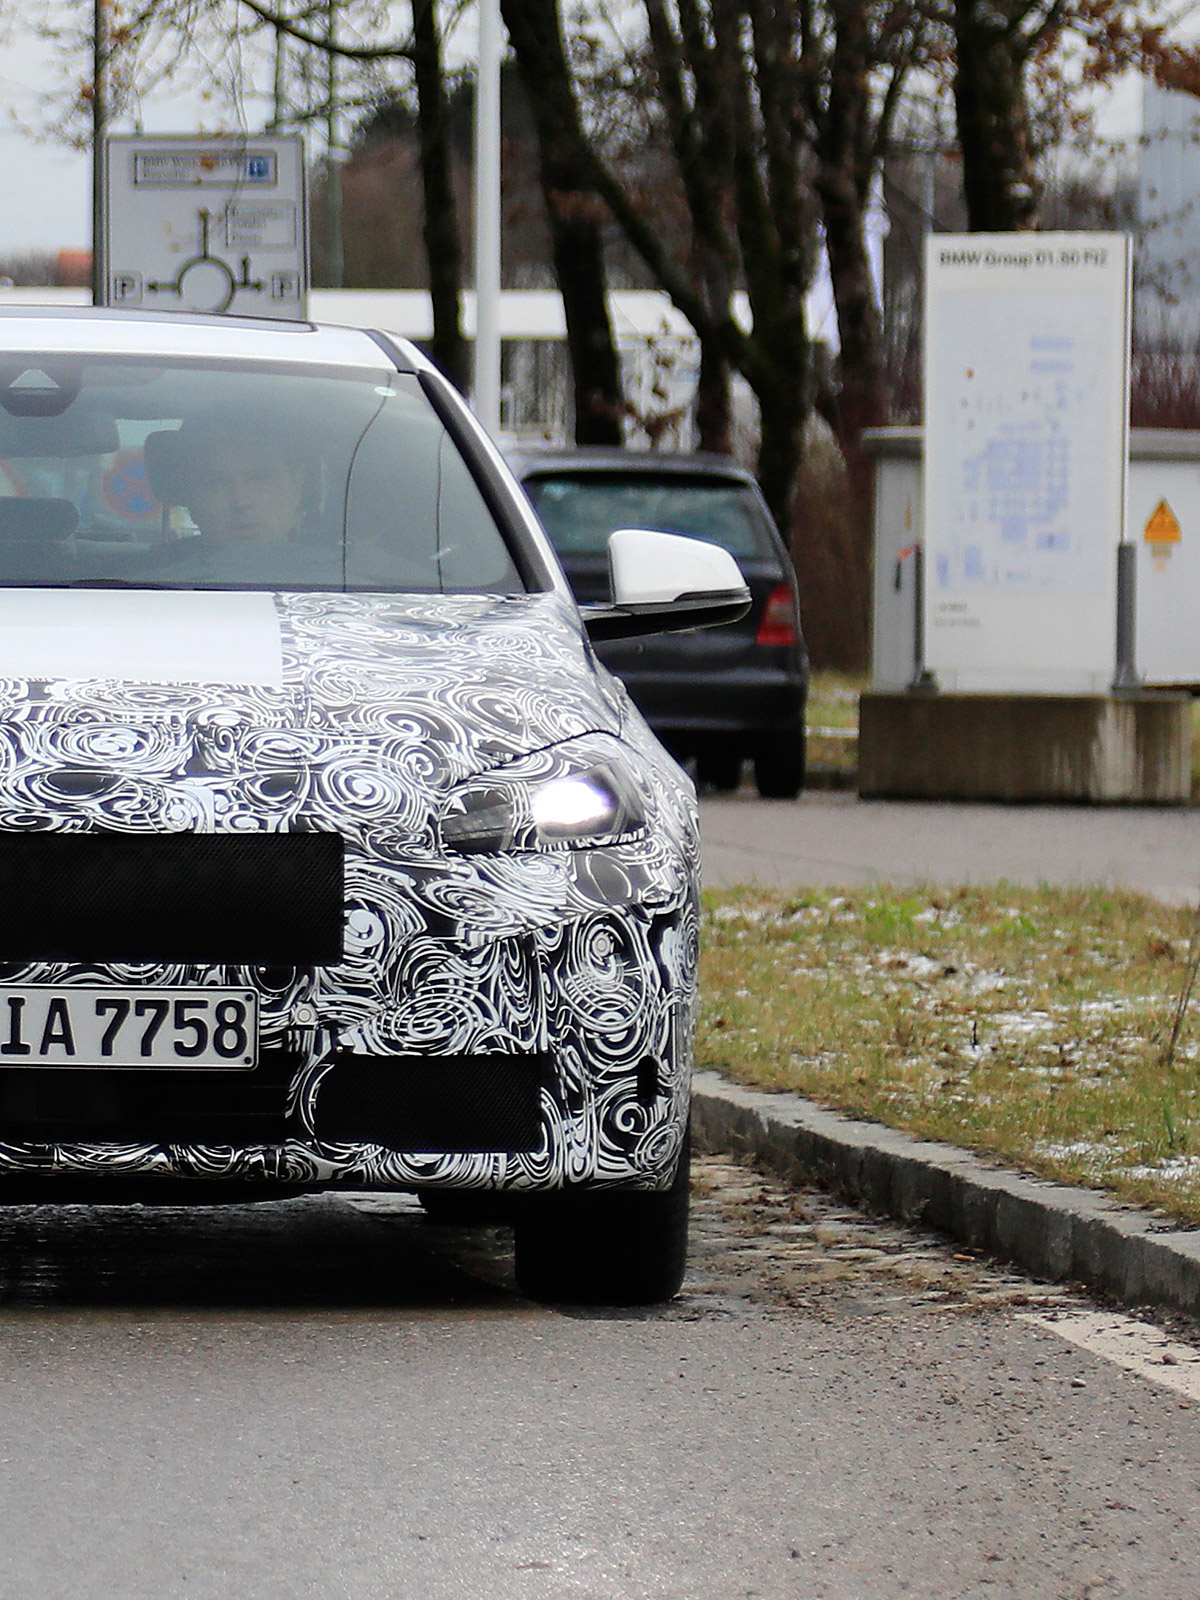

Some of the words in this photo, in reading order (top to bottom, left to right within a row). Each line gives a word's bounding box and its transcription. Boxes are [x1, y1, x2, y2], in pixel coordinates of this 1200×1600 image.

[940, 251, 979, 265] BMW
[984, 251, 1031, 268] Group
[121, 276, 135, 297] P
[280, 276, 292, 297] P
[1, 996, 76, 1056] IA
[95, 998, 247, 1059] 7758
